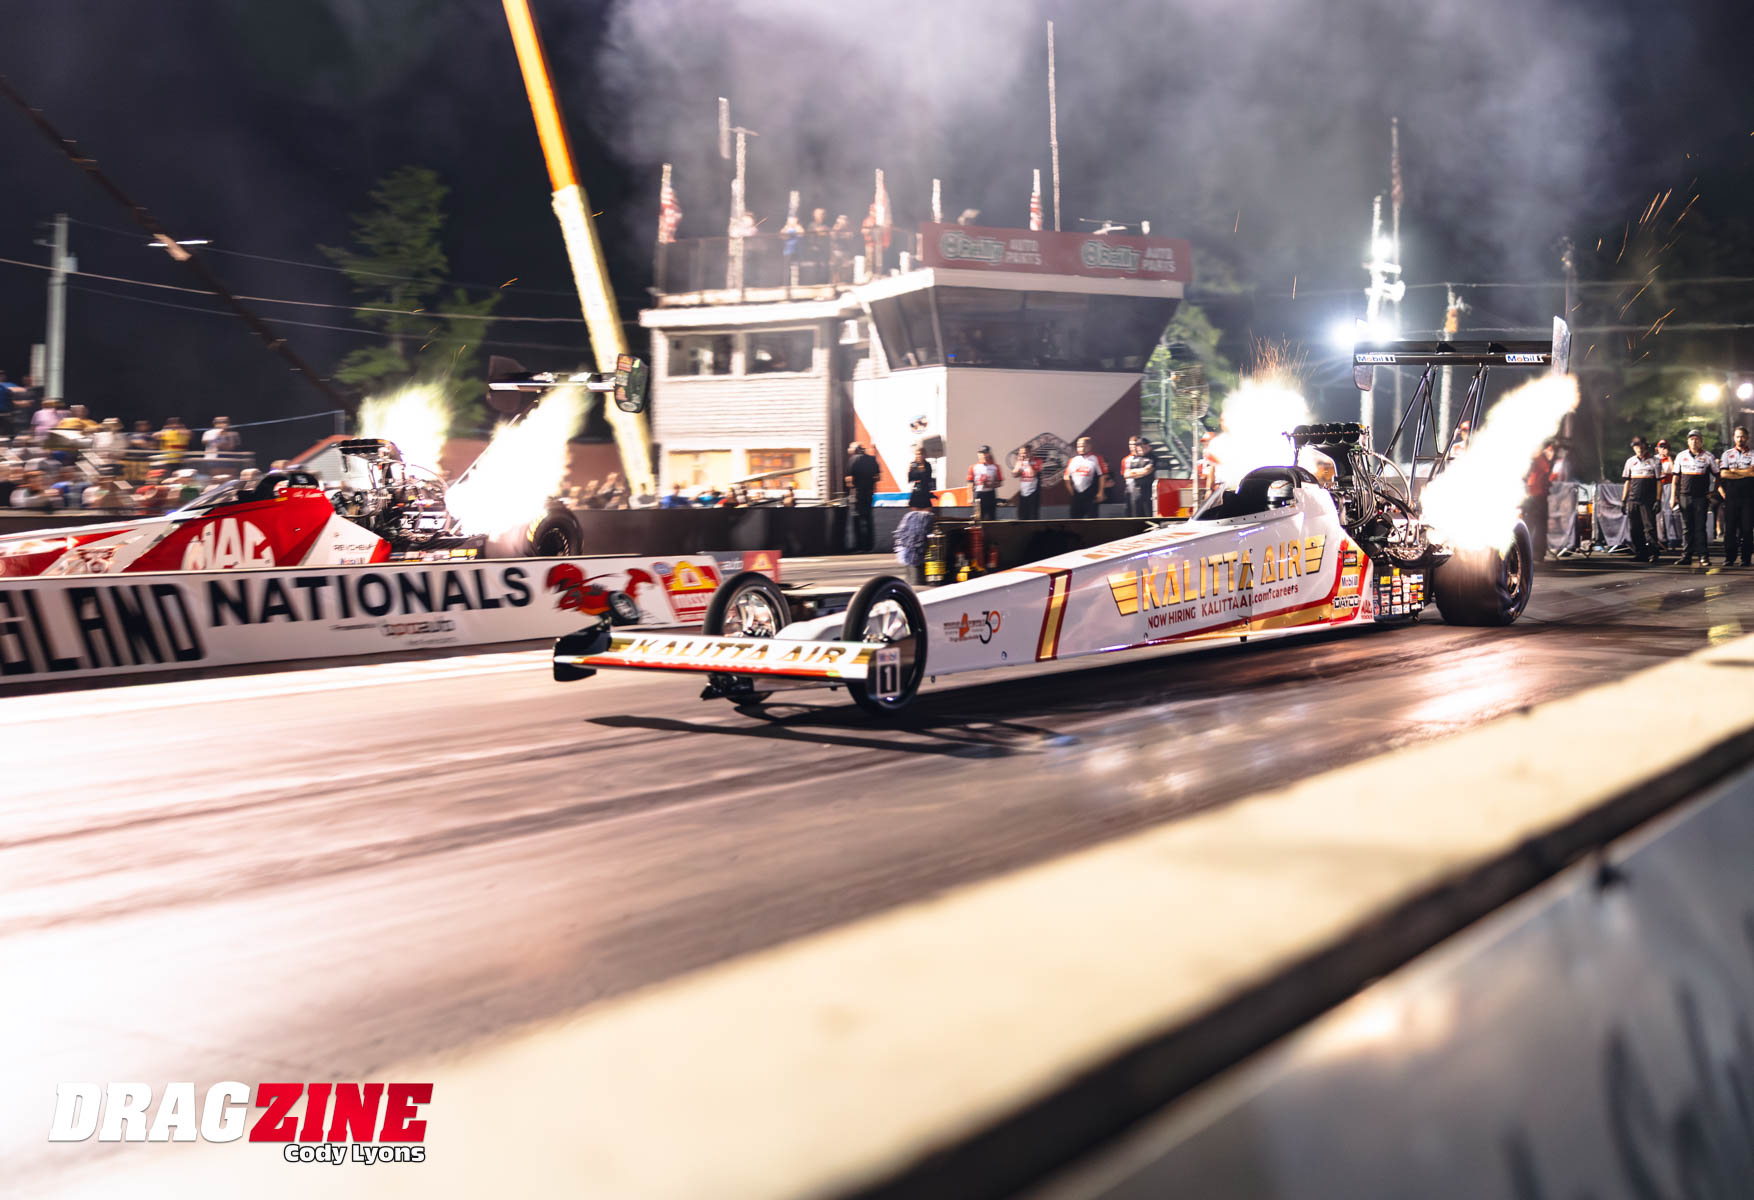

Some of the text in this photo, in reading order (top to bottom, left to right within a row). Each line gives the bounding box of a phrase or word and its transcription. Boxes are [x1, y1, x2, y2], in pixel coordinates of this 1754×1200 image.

[1009, 239, 1039, 252] AUTO
[1005, 251, 1042, 266] PARTS
[1146, 247, 1173, 260] AUTO
[1142, 259, 1177, 273] PARTS
[1357, 355, 1384, 363] Mobil
[1506, 354, 1535, 363] Mobil
[1142, 538, 1302, 611] KALITTA AIR
[207, 567, 534, 627] NATIONALS
[1333, 595, 1359, 609] DAYCO
[1148, 613, 1167, 630] NOW
[1168, 606, 1196, 625] HIRING
[981, 610, 1001, 644] 30
[630, 639, 849, 664] KALITTA AIR
[884, 665, 893, 692] 1
